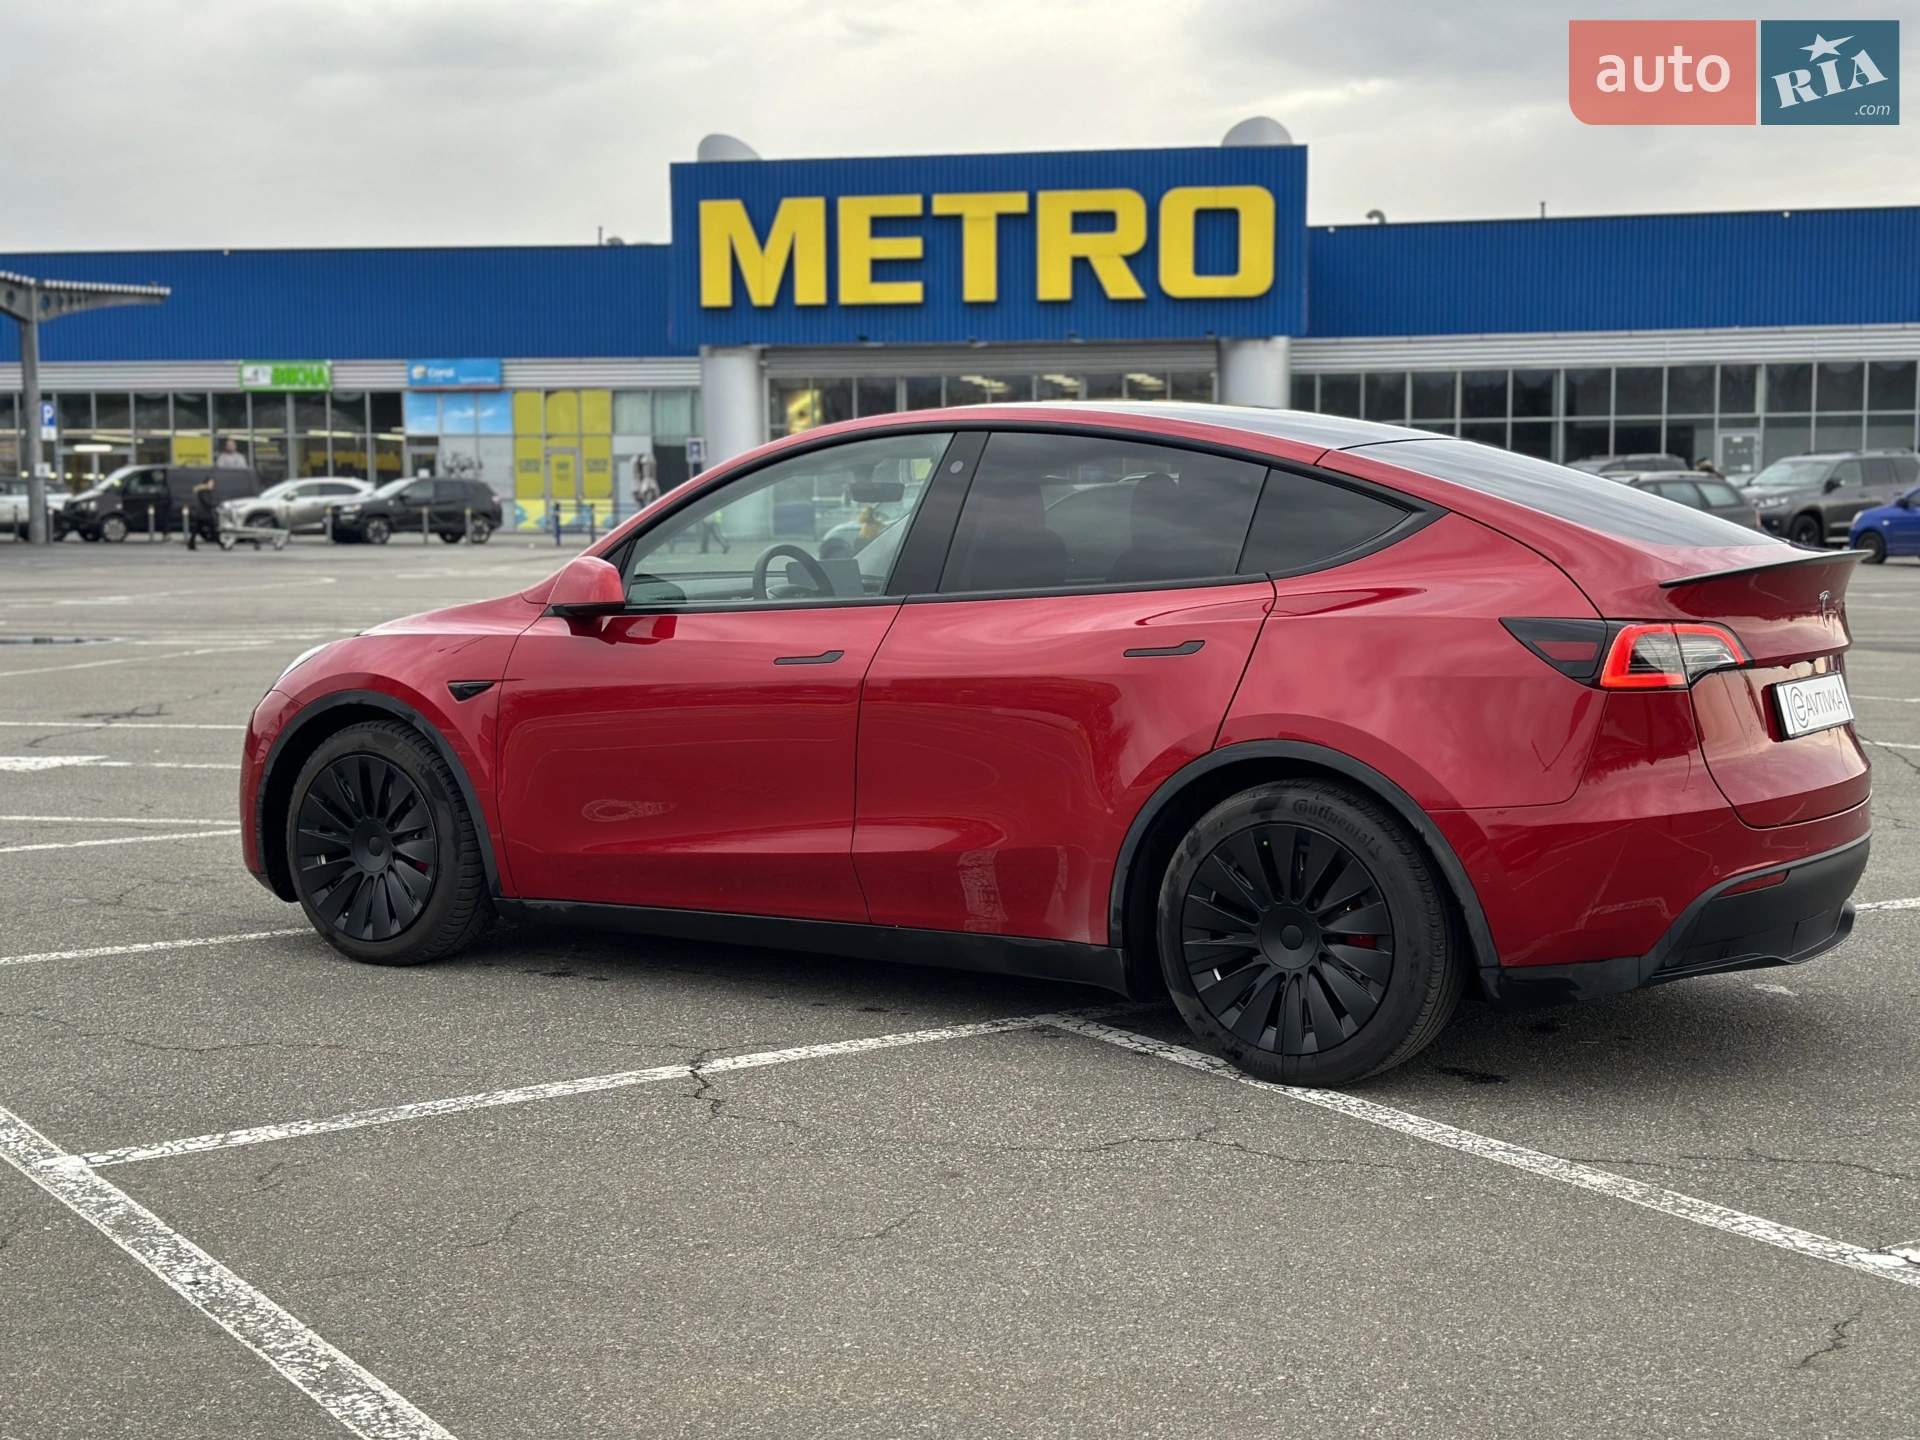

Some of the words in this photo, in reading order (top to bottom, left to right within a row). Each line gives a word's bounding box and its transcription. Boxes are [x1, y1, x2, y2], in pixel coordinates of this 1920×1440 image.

[699, 185, 1275, 308] METRO
[43, 403, 54, 425] P
[1292, 798, 1375, 848] Continental
